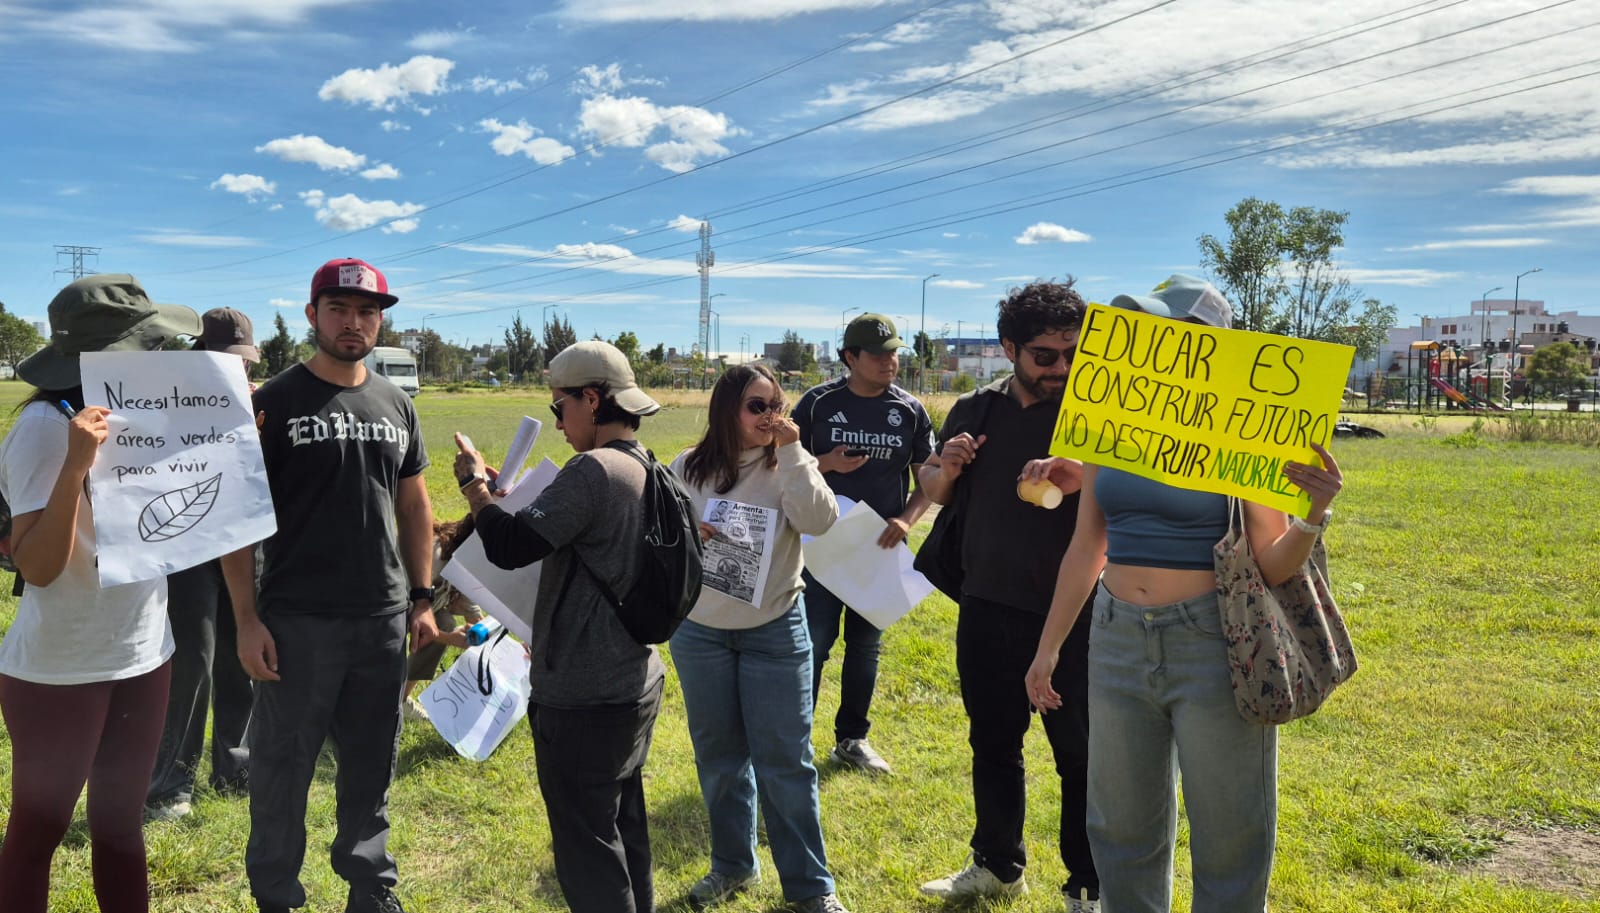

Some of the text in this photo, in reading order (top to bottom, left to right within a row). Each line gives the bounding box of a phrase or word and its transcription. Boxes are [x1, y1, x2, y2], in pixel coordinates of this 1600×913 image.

[1080, 309, 1304, 396] EDUCAR ES
[103, 381, 231, 412] Necesitamos
[1072, 361, 1329, 449] CONSTRUIR FUTURO
[116, 426, 237, 449] áreas verdes
[287, 411, 409, 453] Ed Hardy
[831, 427, 903, 447] Emirates
[1054, 408, 1089, 447] NO
[1094, 419, 1211, 478] DESTRUIR
[112, 458, 208, 484] para vivir
